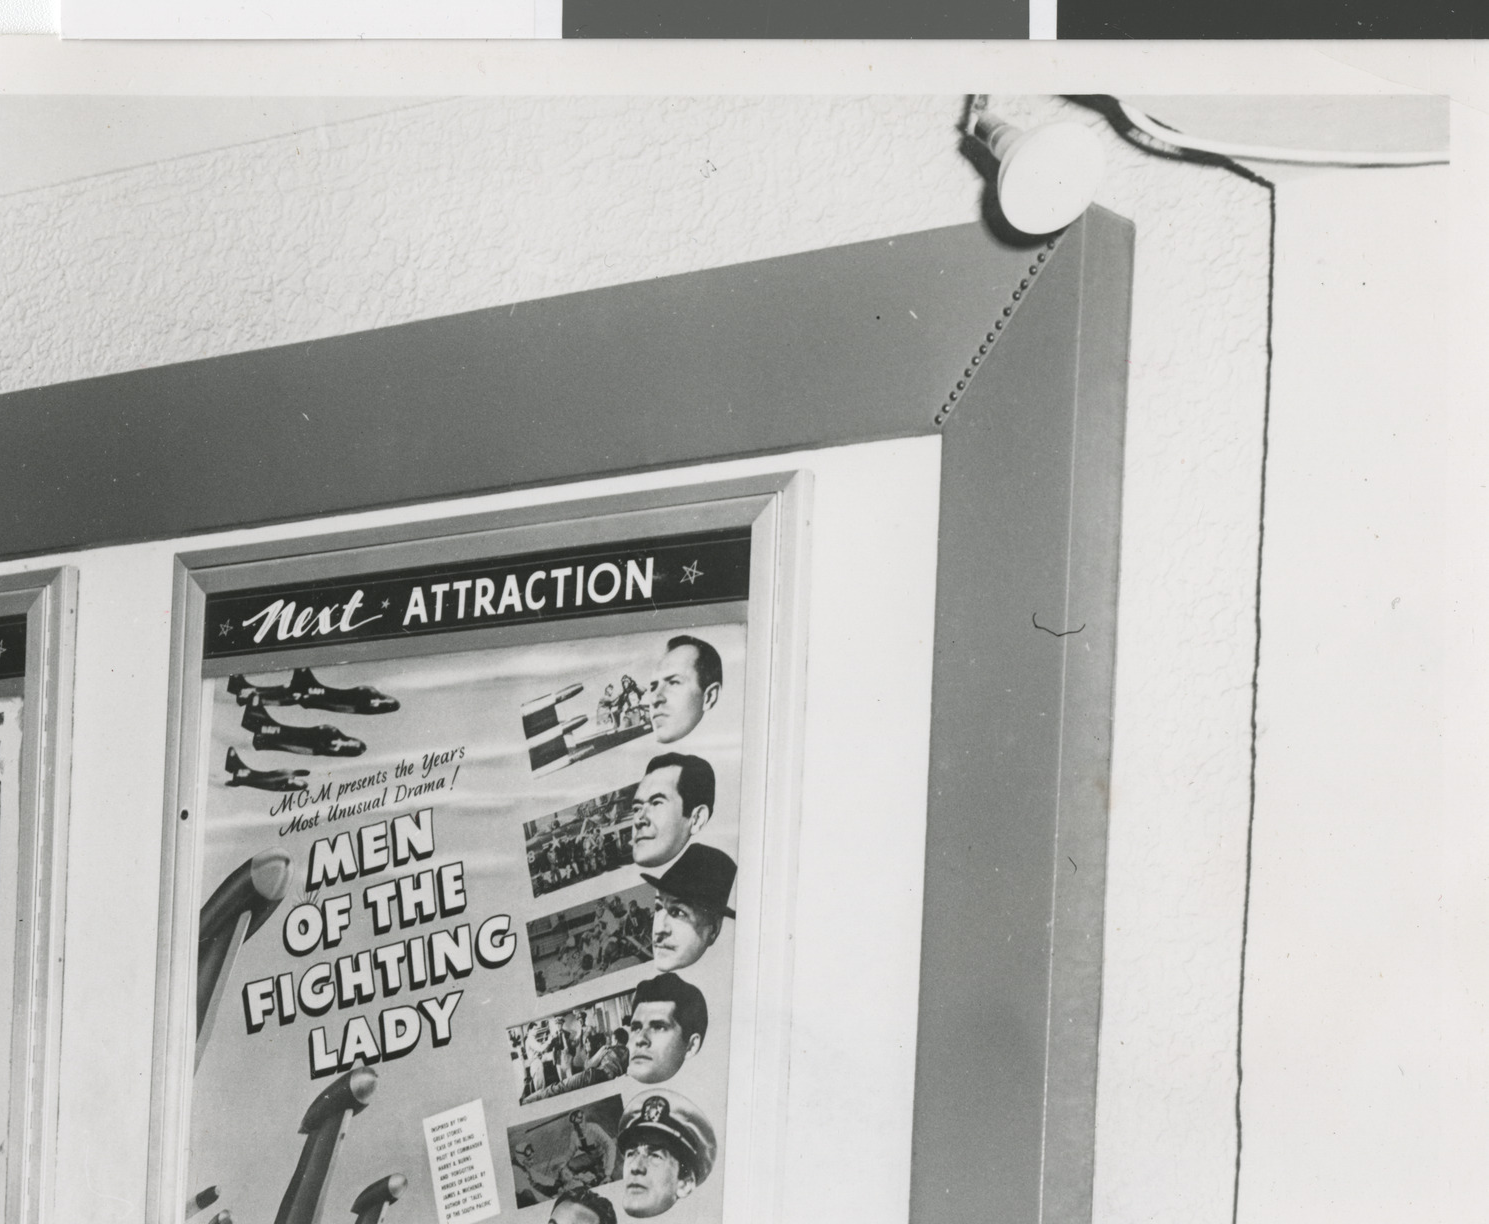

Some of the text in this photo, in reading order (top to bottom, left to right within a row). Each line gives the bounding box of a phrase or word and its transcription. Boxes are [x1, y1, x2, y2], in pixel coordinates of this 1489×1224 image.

[242, 557, 655, 643] Next ATTRACTION
[279, 812, 320, 836] Most
[327, 787, 388, 823] Unusual
[336, 770, 388, 800] presents
[395, 759, 414, 779] the
[422, 746, 465, 778] Year's
[305, 807, 435, 892] MEN
[283, 861, 467, 957] OF THE
[242, 914, 517, 1035] FIGHTING
[308, 990, 464, 1080] LADY
